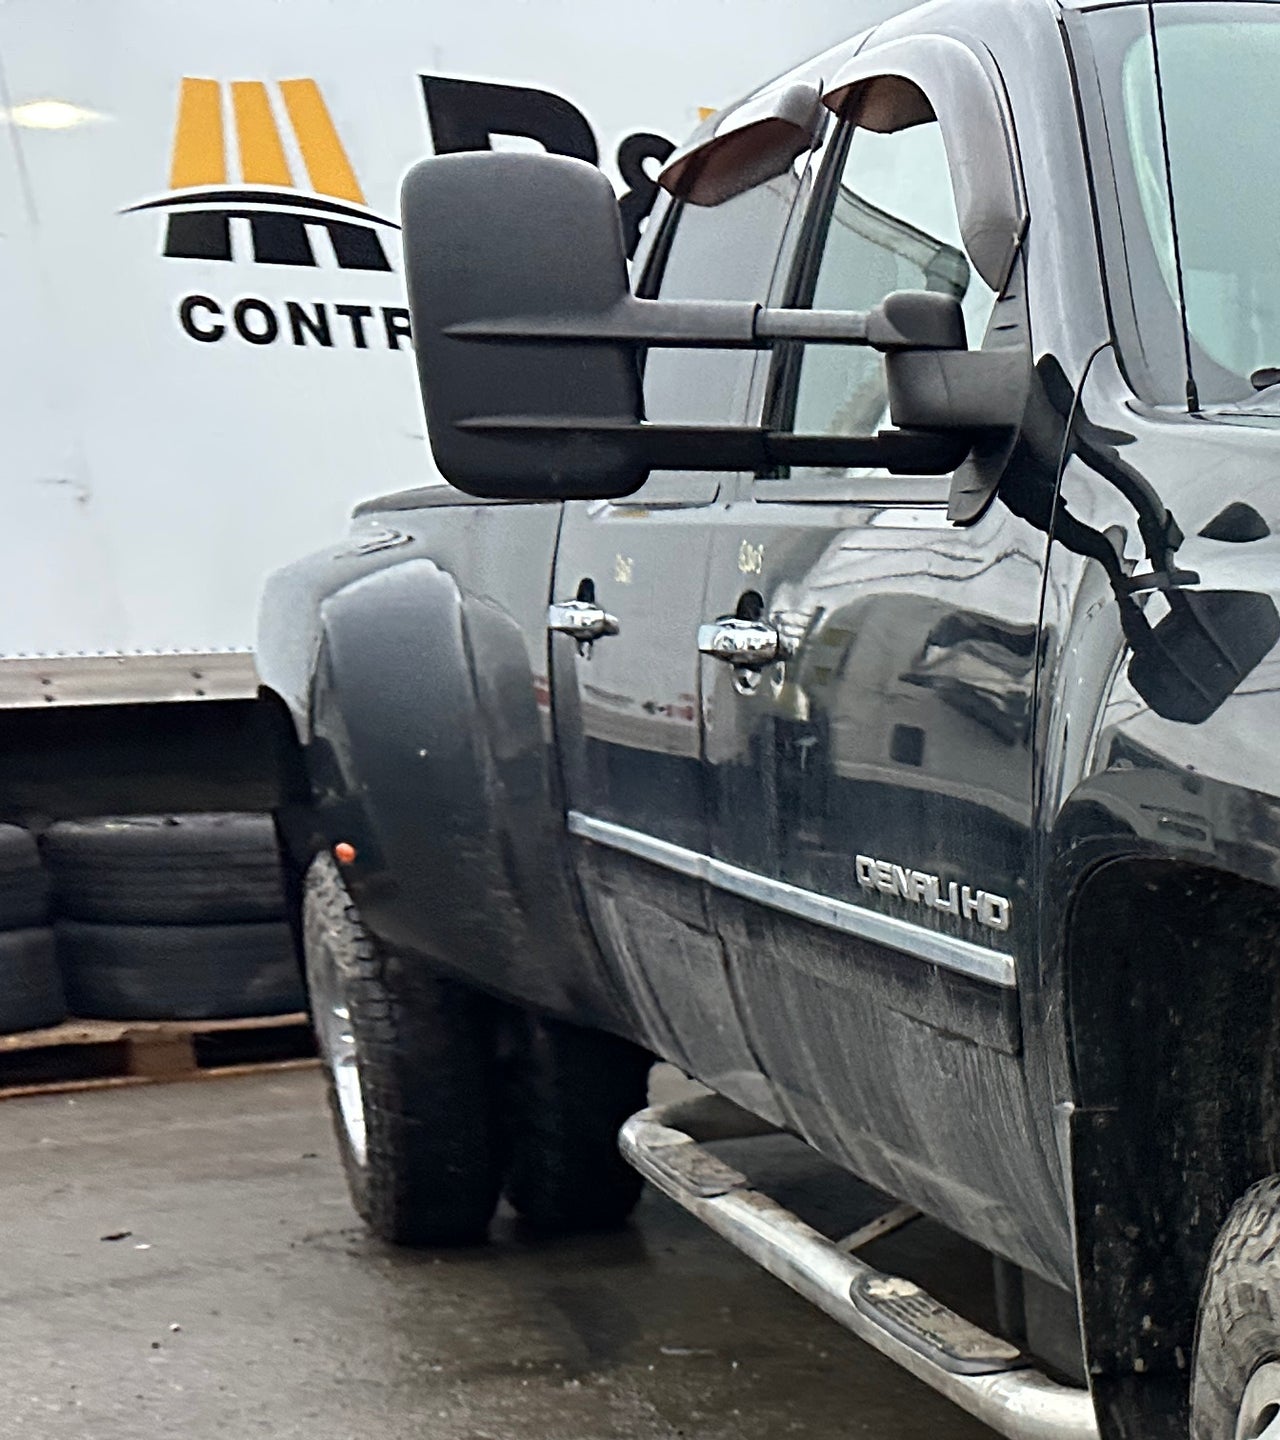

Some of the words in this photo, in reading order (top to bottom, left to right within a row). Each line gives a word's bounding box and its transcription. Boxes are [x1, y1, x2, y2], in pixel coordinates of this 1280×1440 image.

[179, 295, 412, 349] CONTR
[855, 854, 960, 916] DENALI
[961, 885, 1012, 931] HD
